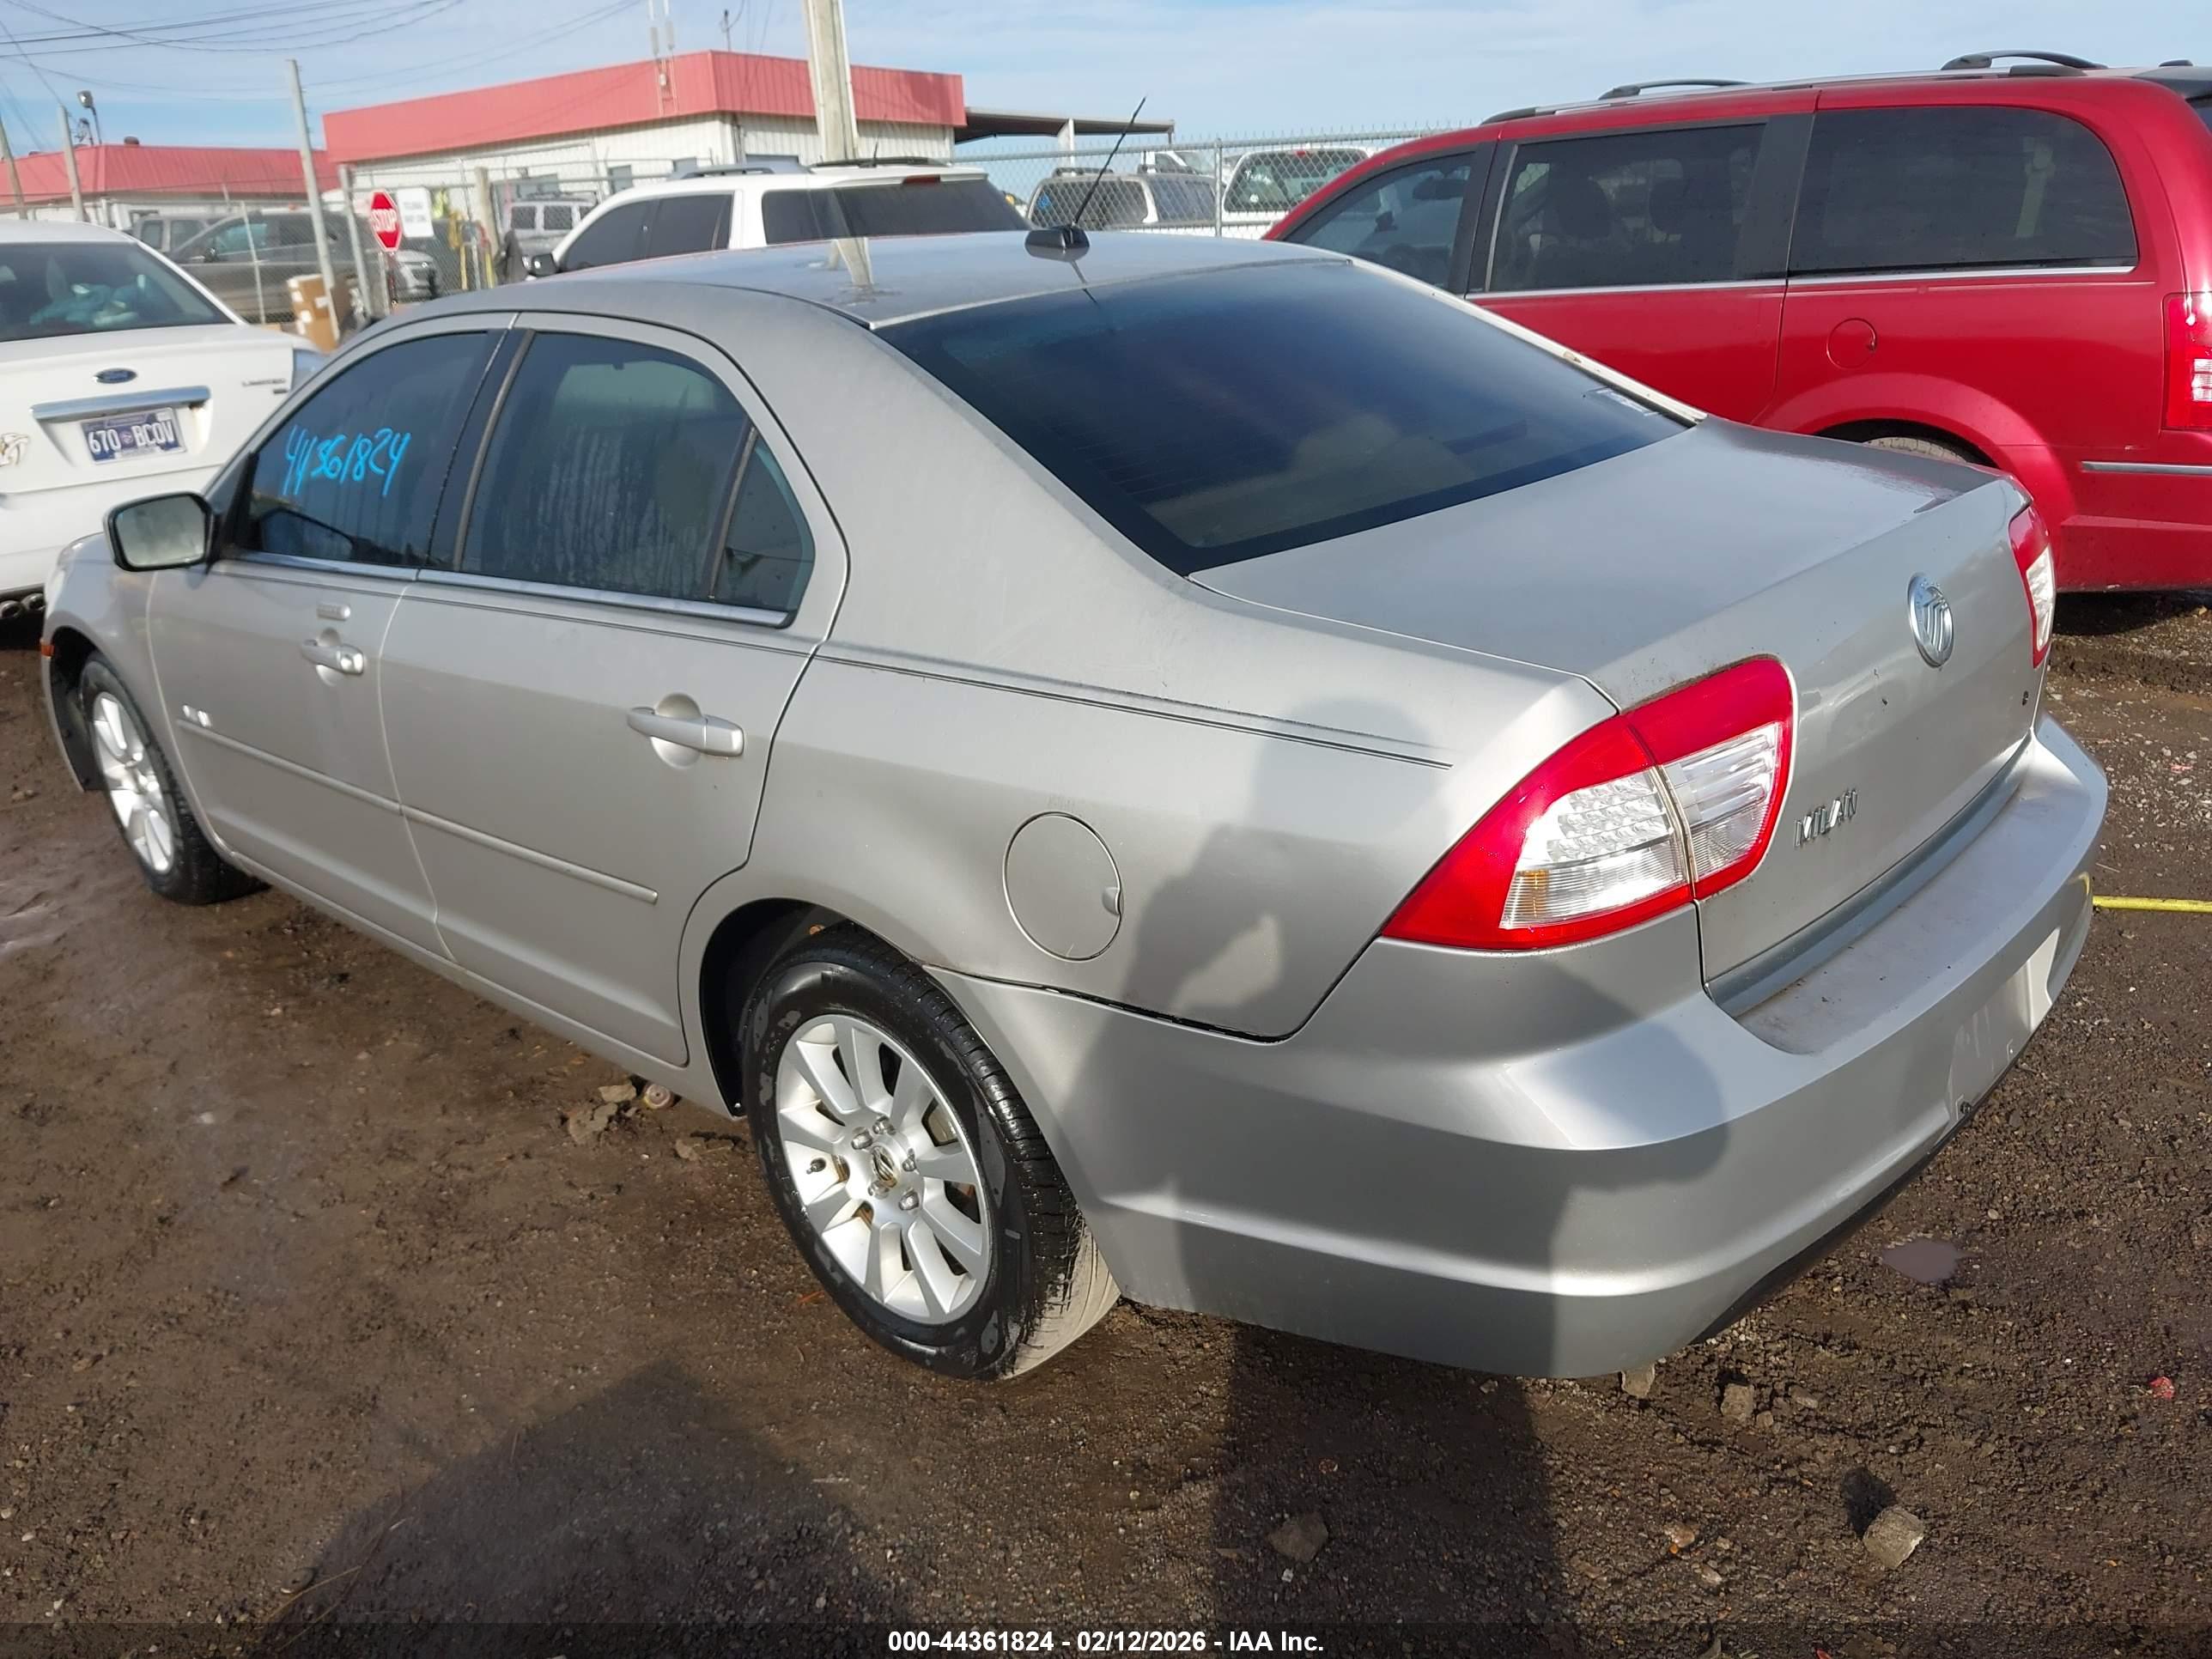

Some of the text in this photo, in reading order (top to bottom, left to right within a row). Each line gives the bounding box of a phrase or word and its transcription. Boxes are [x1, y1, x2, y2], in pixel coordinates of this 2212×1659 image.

[370, 208, 398, 233] STOP
[88, 428, 121, 454] 670
[1794, 788, 1858, 848] MILAN
